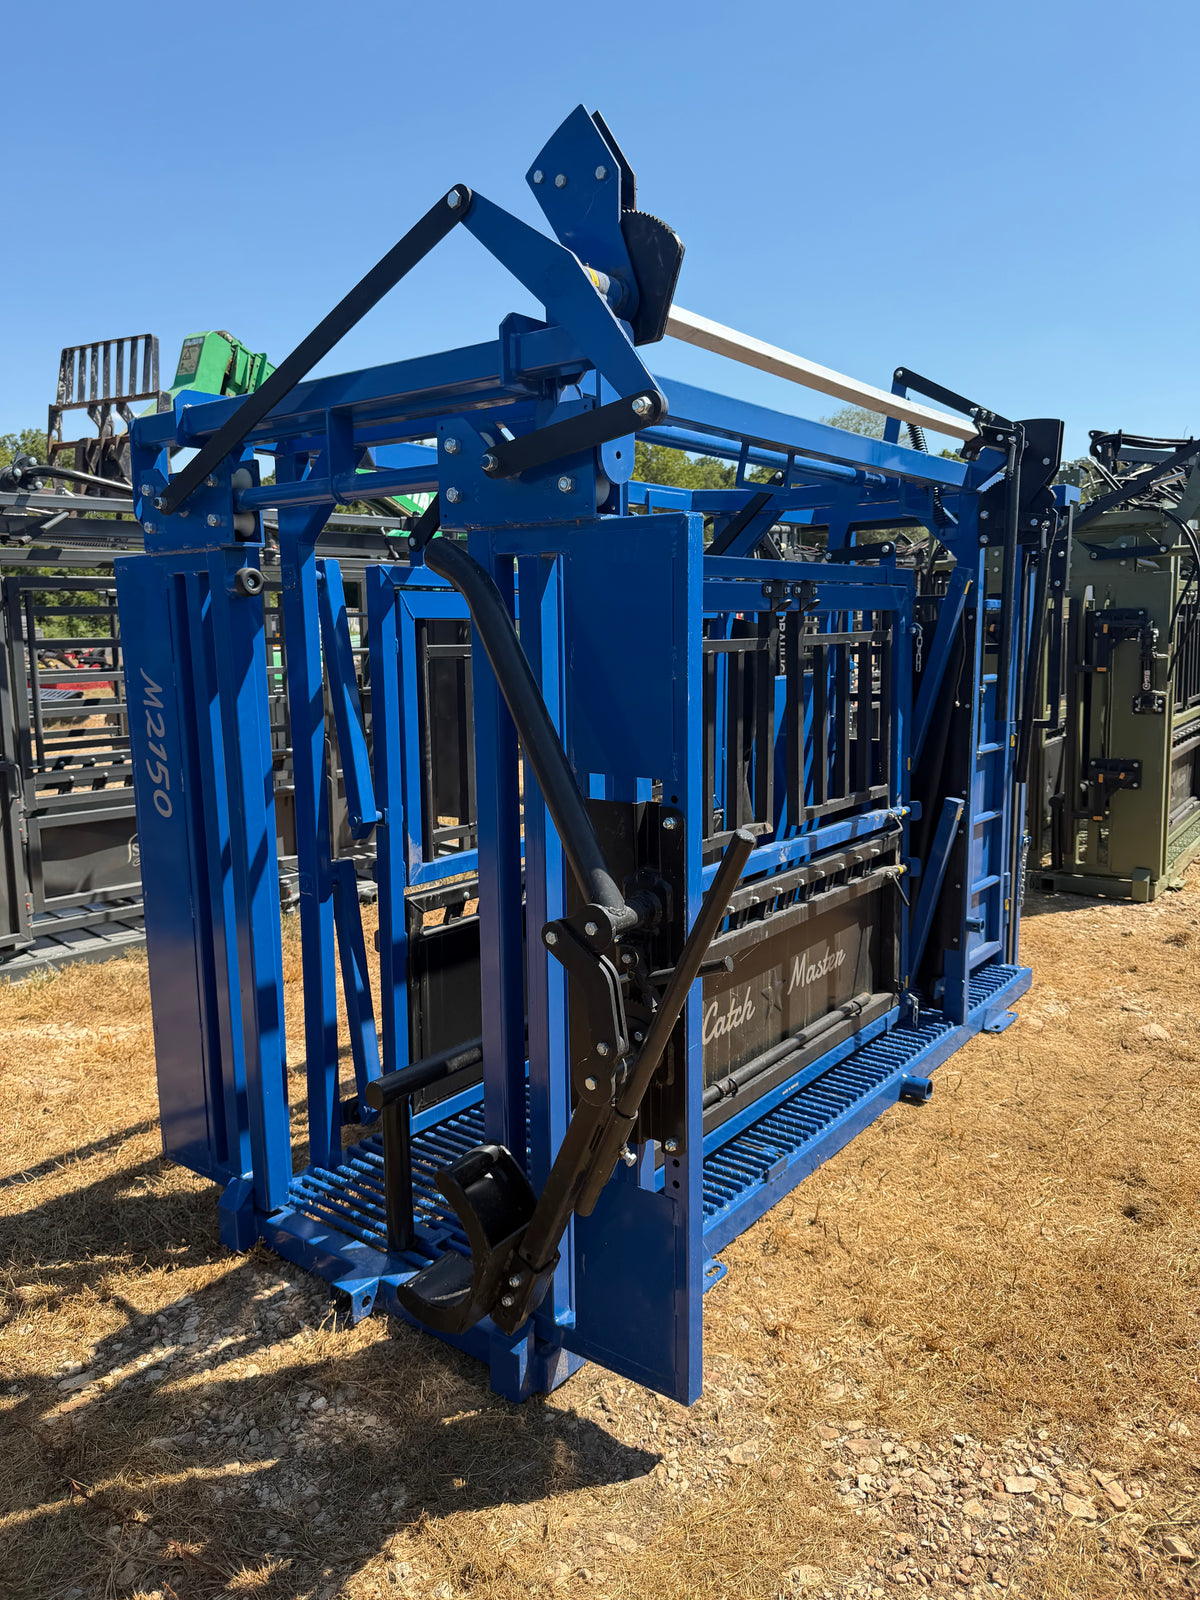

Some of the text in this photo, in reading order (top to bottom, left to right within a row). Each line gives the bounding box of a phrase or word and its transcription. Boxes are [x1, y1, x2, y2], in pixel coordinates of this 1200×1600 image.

[139, 667, 173, 818] M2150
[702, 946, 846, 1045] Catch Master
